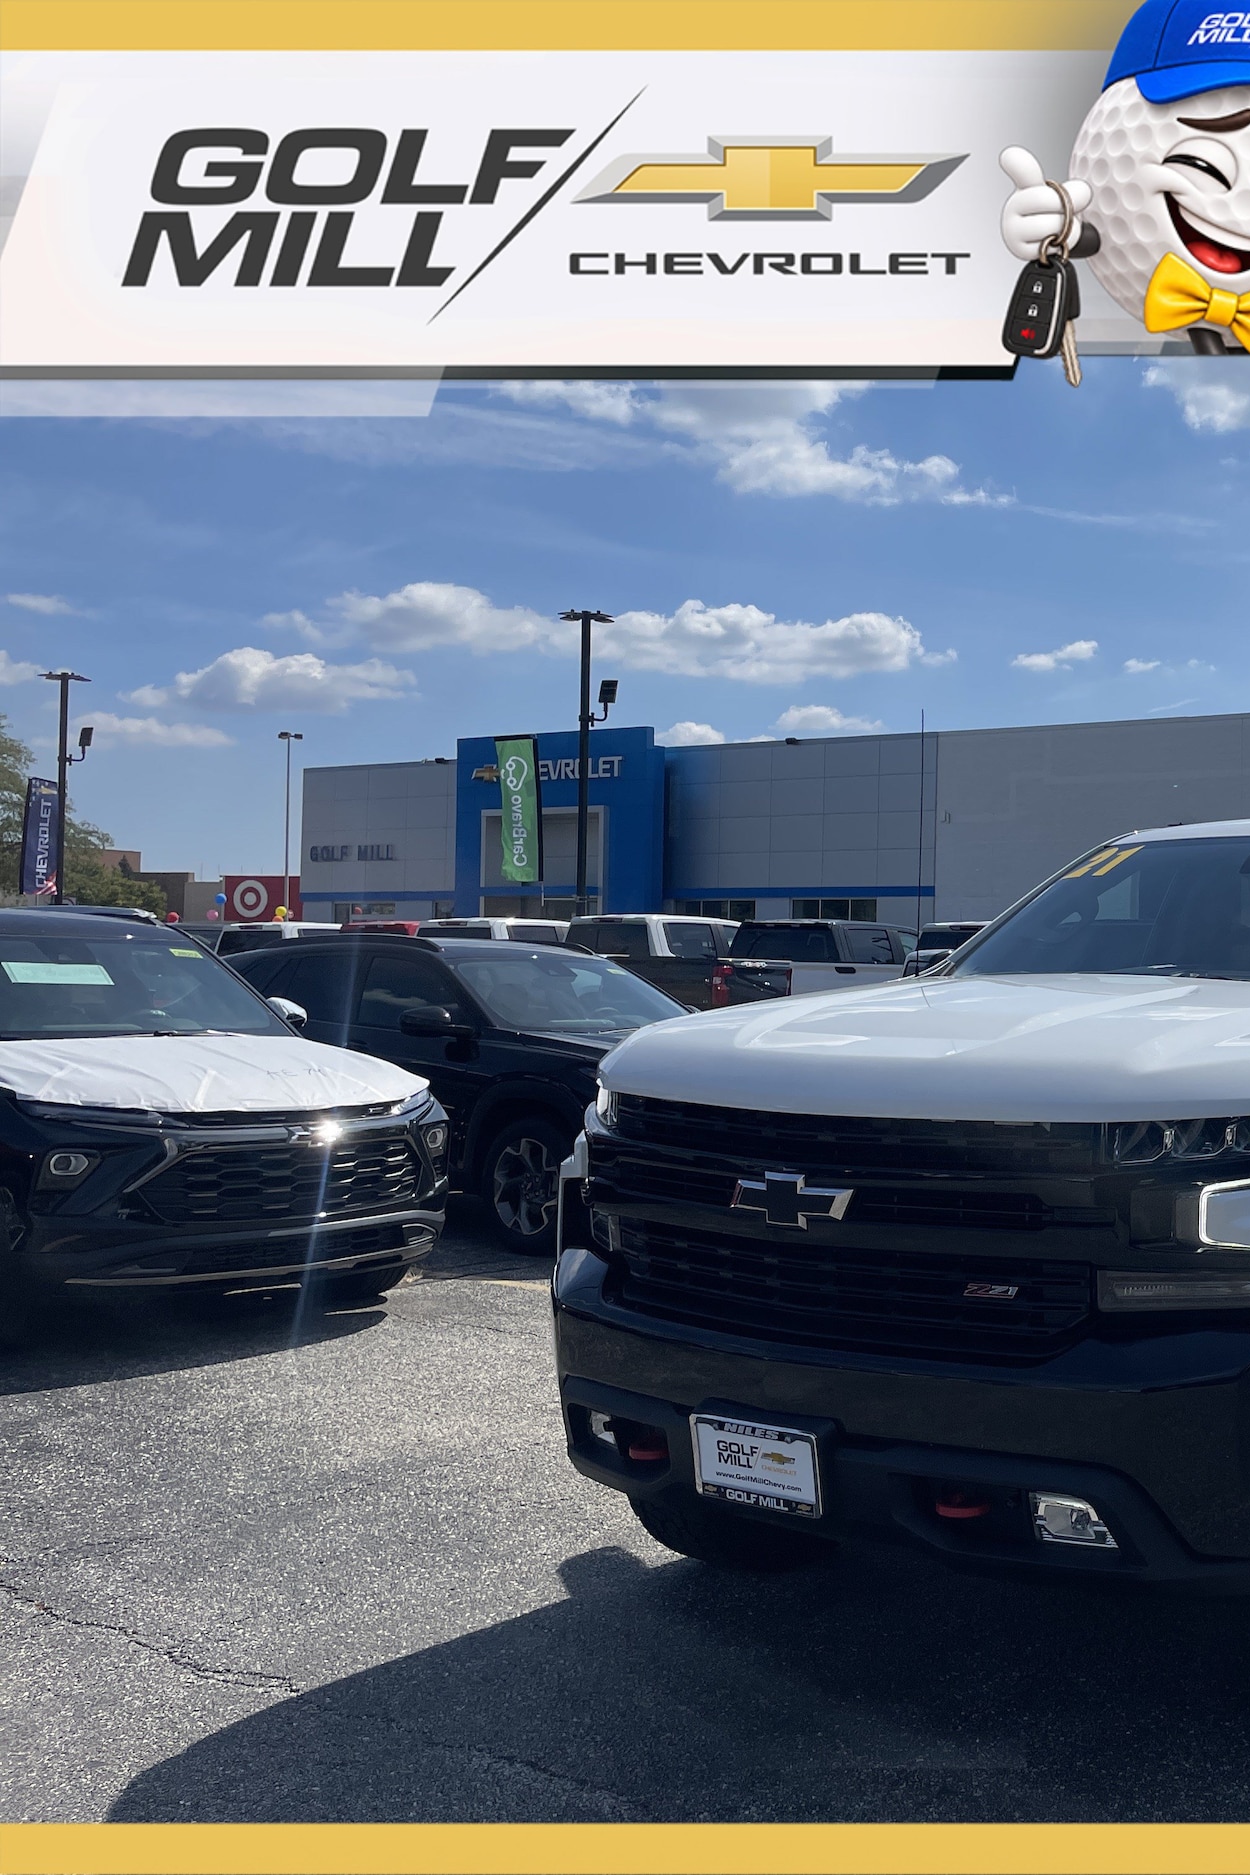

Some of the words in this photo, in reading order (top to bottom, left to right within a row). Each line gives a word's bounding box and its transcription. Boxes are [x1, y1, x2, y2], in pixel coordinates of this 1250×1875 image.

[539, 756, 622, 781] EVRLET
[35, 798, 52, 888] CHEVROLET
[310, 845, 349, 862] GOLF
[357, 844, 395, 861] MILL
[1061, 845, 1146, 879] 21
[723, 1422, 779, 1440] NILES
[716, 1439, 759, 1457] GOLF
[718, 1452, 753, 1469] MILL
[715, 1471, 802, 1492] www.GolfMillChevy.com
[726, 1488, 758, 1505] GOLF
[759, 1496, 789, 1511] MILL
